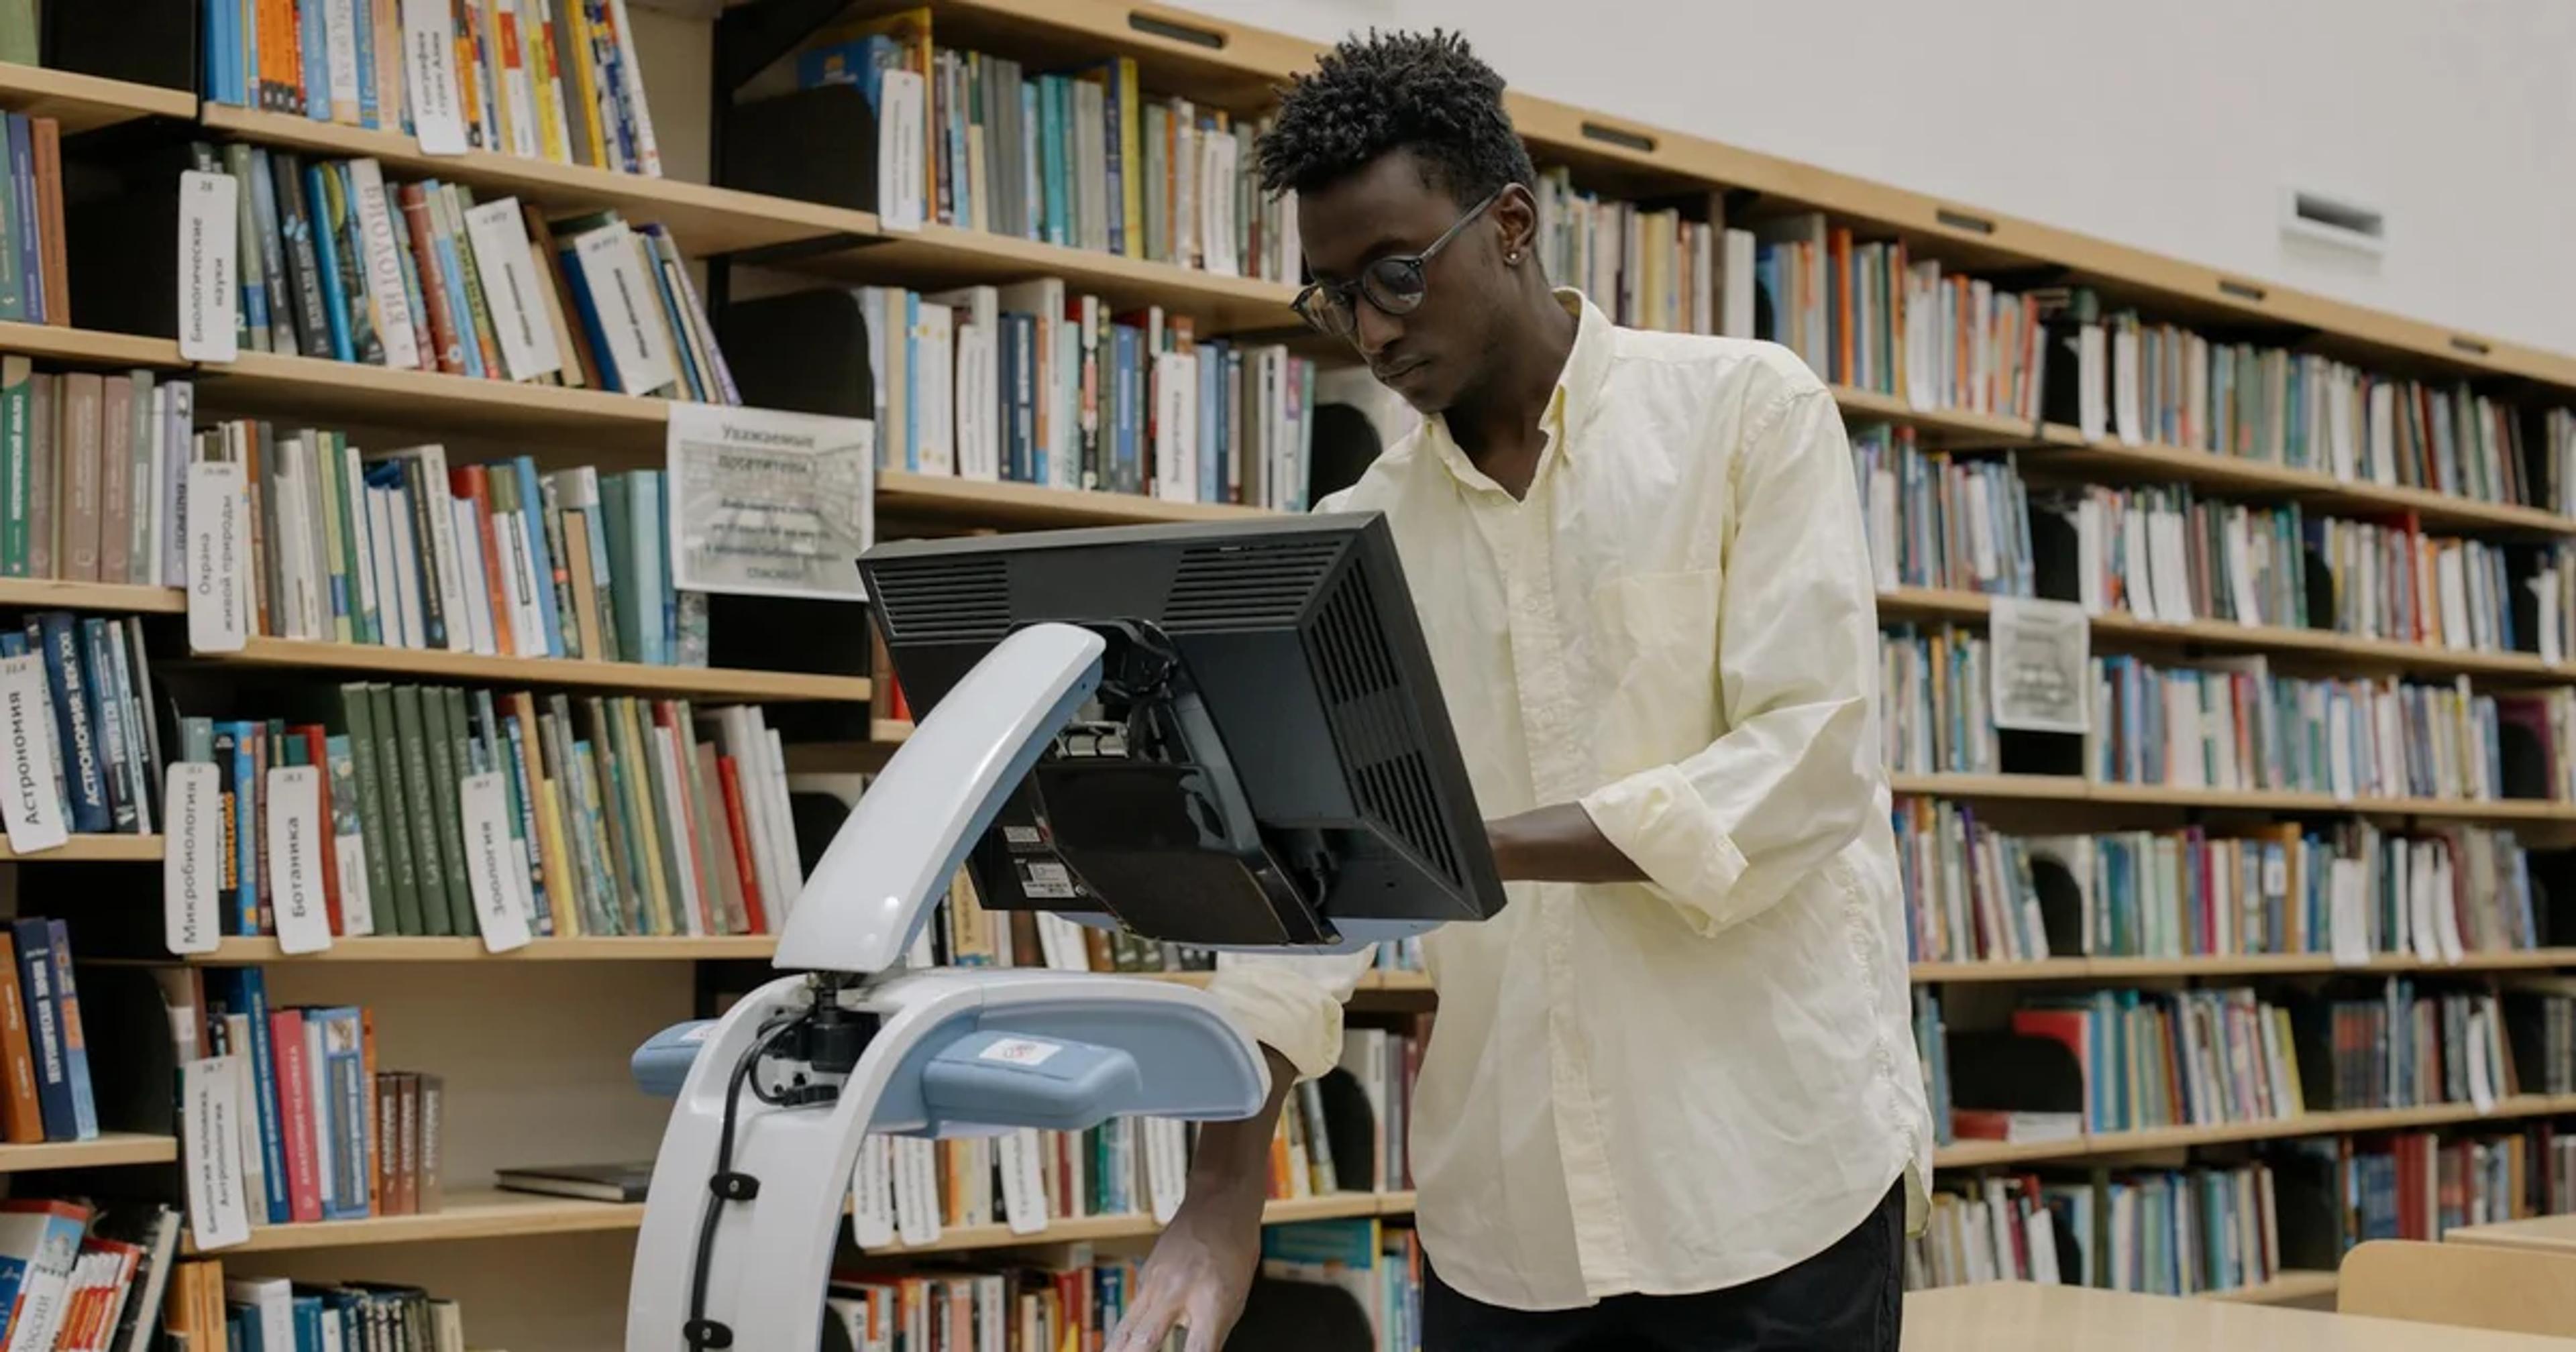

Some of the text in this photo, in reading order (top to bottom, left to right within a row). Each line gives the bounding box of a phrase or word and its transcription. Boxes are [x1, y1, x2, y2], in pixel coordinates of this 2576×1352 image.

[191, 217, 203, 343] Биологические
[214, 258, 227, 306] науки
[364, 184, 408, 327] БИОЛОГИЯ
[198, 532, 211, 596] Охрана
[221, 495, 233, 632] живой природы
[8, 691, 40, 825] Астрономия
[180, 781, 197, 944] Микробиология
[288, 816, 307, 918] Ботаника
[480, 822, 506, 917] Зоология
[215, 1103, 229, 1206] Антропология
